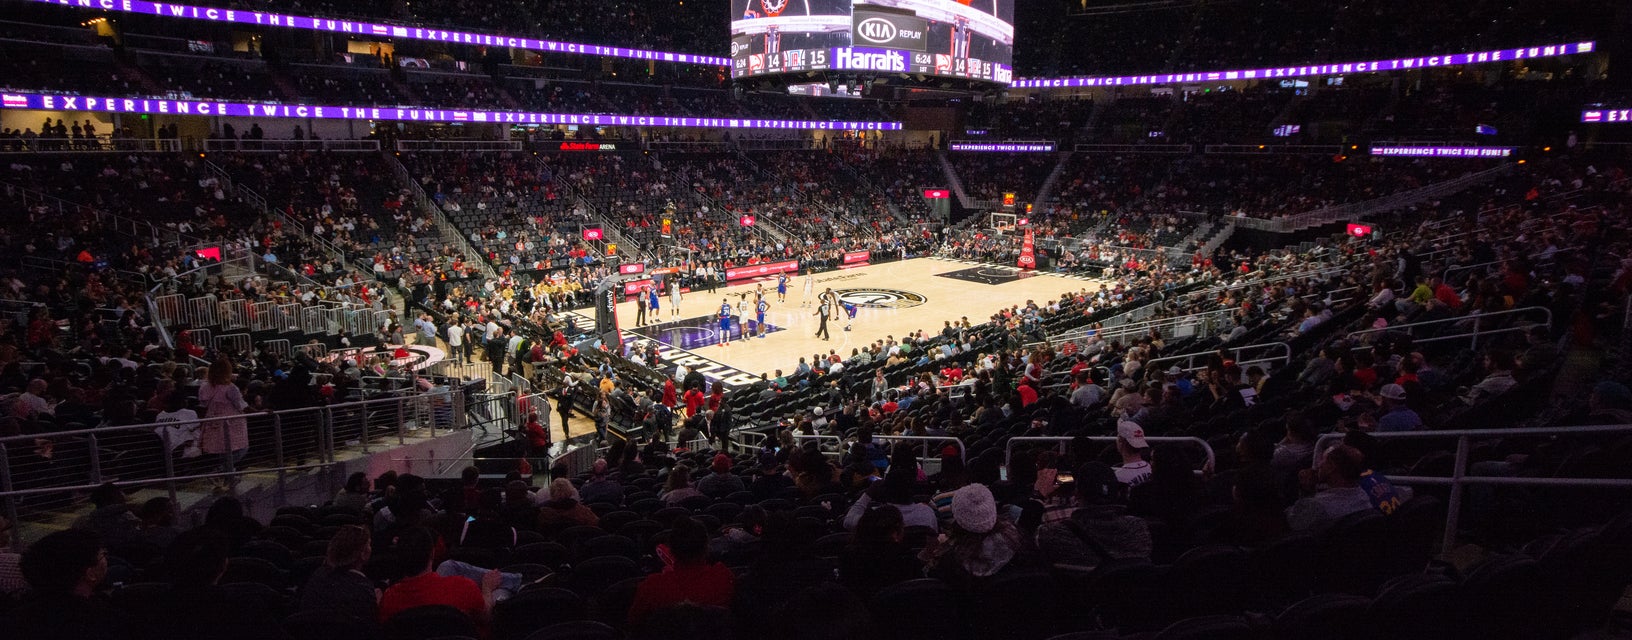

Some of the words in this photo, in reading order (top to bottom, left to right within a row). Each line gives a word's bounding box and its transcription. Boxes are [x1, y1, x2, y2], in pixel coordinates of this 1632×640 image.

[154, 4, 235, 21] TWICE
[255, 13, 295, 26] THE
[864, 22, 891, 38] KIA
[900, 30, 922, 39] REPLAY
[416, 29, 527, 48] EXPERIENCE
[539, 41, 585, 52] TWICE
[596, 46, 618, 56] THE
[768, 54, 779, 67] 14
[811, 50, 825, 65] 15
[837, 47, 906, 71] Harrah's
[915, 54, 931, 64] 6:24
[1265, 62, 1378, 78] EXPERIENCE
[1392, 56, 1452, 69] TWICE
[1467, 51, 1501, 63] THE
[1516, 45, 1566, 58] FUN!
[955, 58, 965, 73] 14
[982, 62, 991, 76] 15
[1079, 77, 1121, 86] TWICE
[1132, 75, 1157, 84] THE
[44, 95, 227, 114] EXPERIENCE
[248, 105, 322, 118] TWICE
[342, 108, 379, 120] THE
[495, 113, 599, 124] EXPERIENCE
[611, 115, 654, 125] TWICE
[665, 117, 687, 126] THE
[757, 120, 836, 129] EXPERIENCE
[843, 121, 882, 130] TWICE
[1383, 147, 1434, 155] EXPERIENCE
[1437, 148, 1462, 156] TWICE
[1464, 148, 1478, 156] THE
